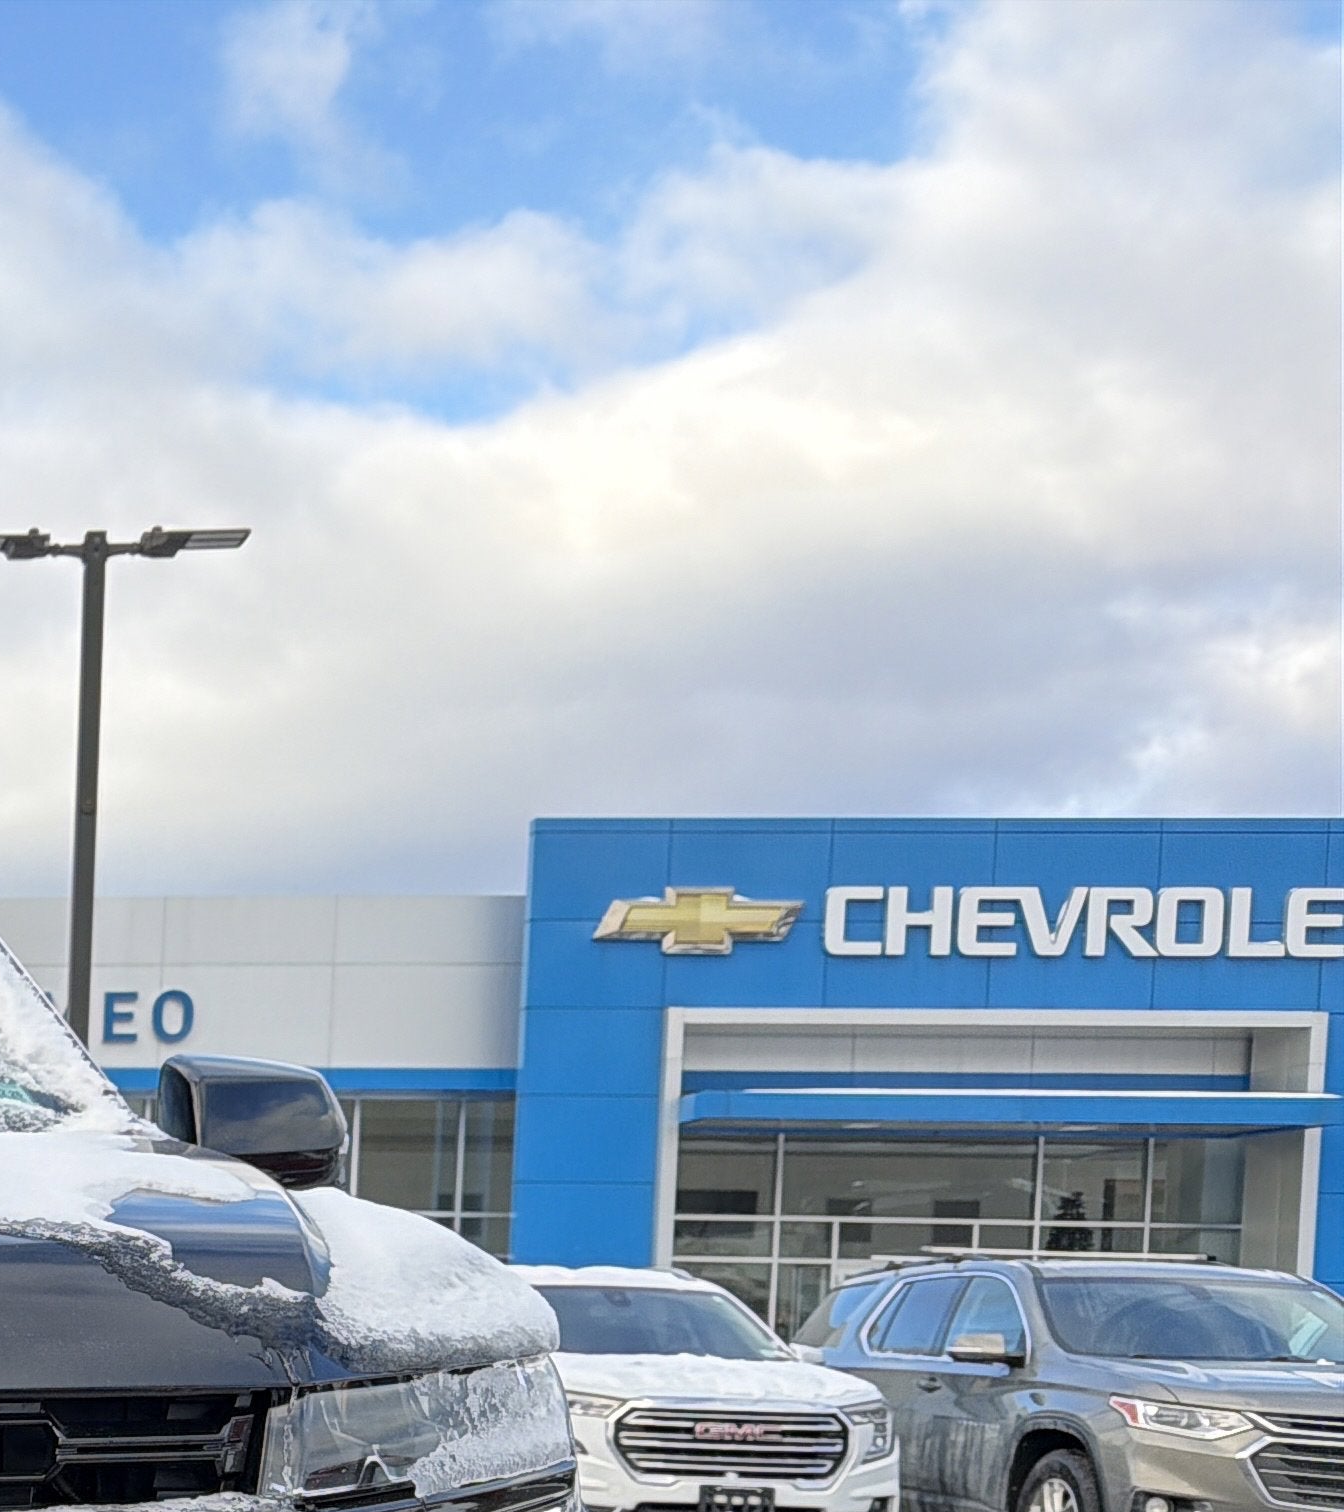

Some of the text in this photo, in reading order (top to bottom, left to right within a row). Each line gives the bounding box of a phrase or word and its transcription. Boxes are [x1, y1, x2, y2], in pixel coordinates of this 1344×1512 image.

[823, 885, 1344, 958] CHEVROLE
[45, 989, 195, 1045] EO
[694, 1421, 783, 1442] GMC
